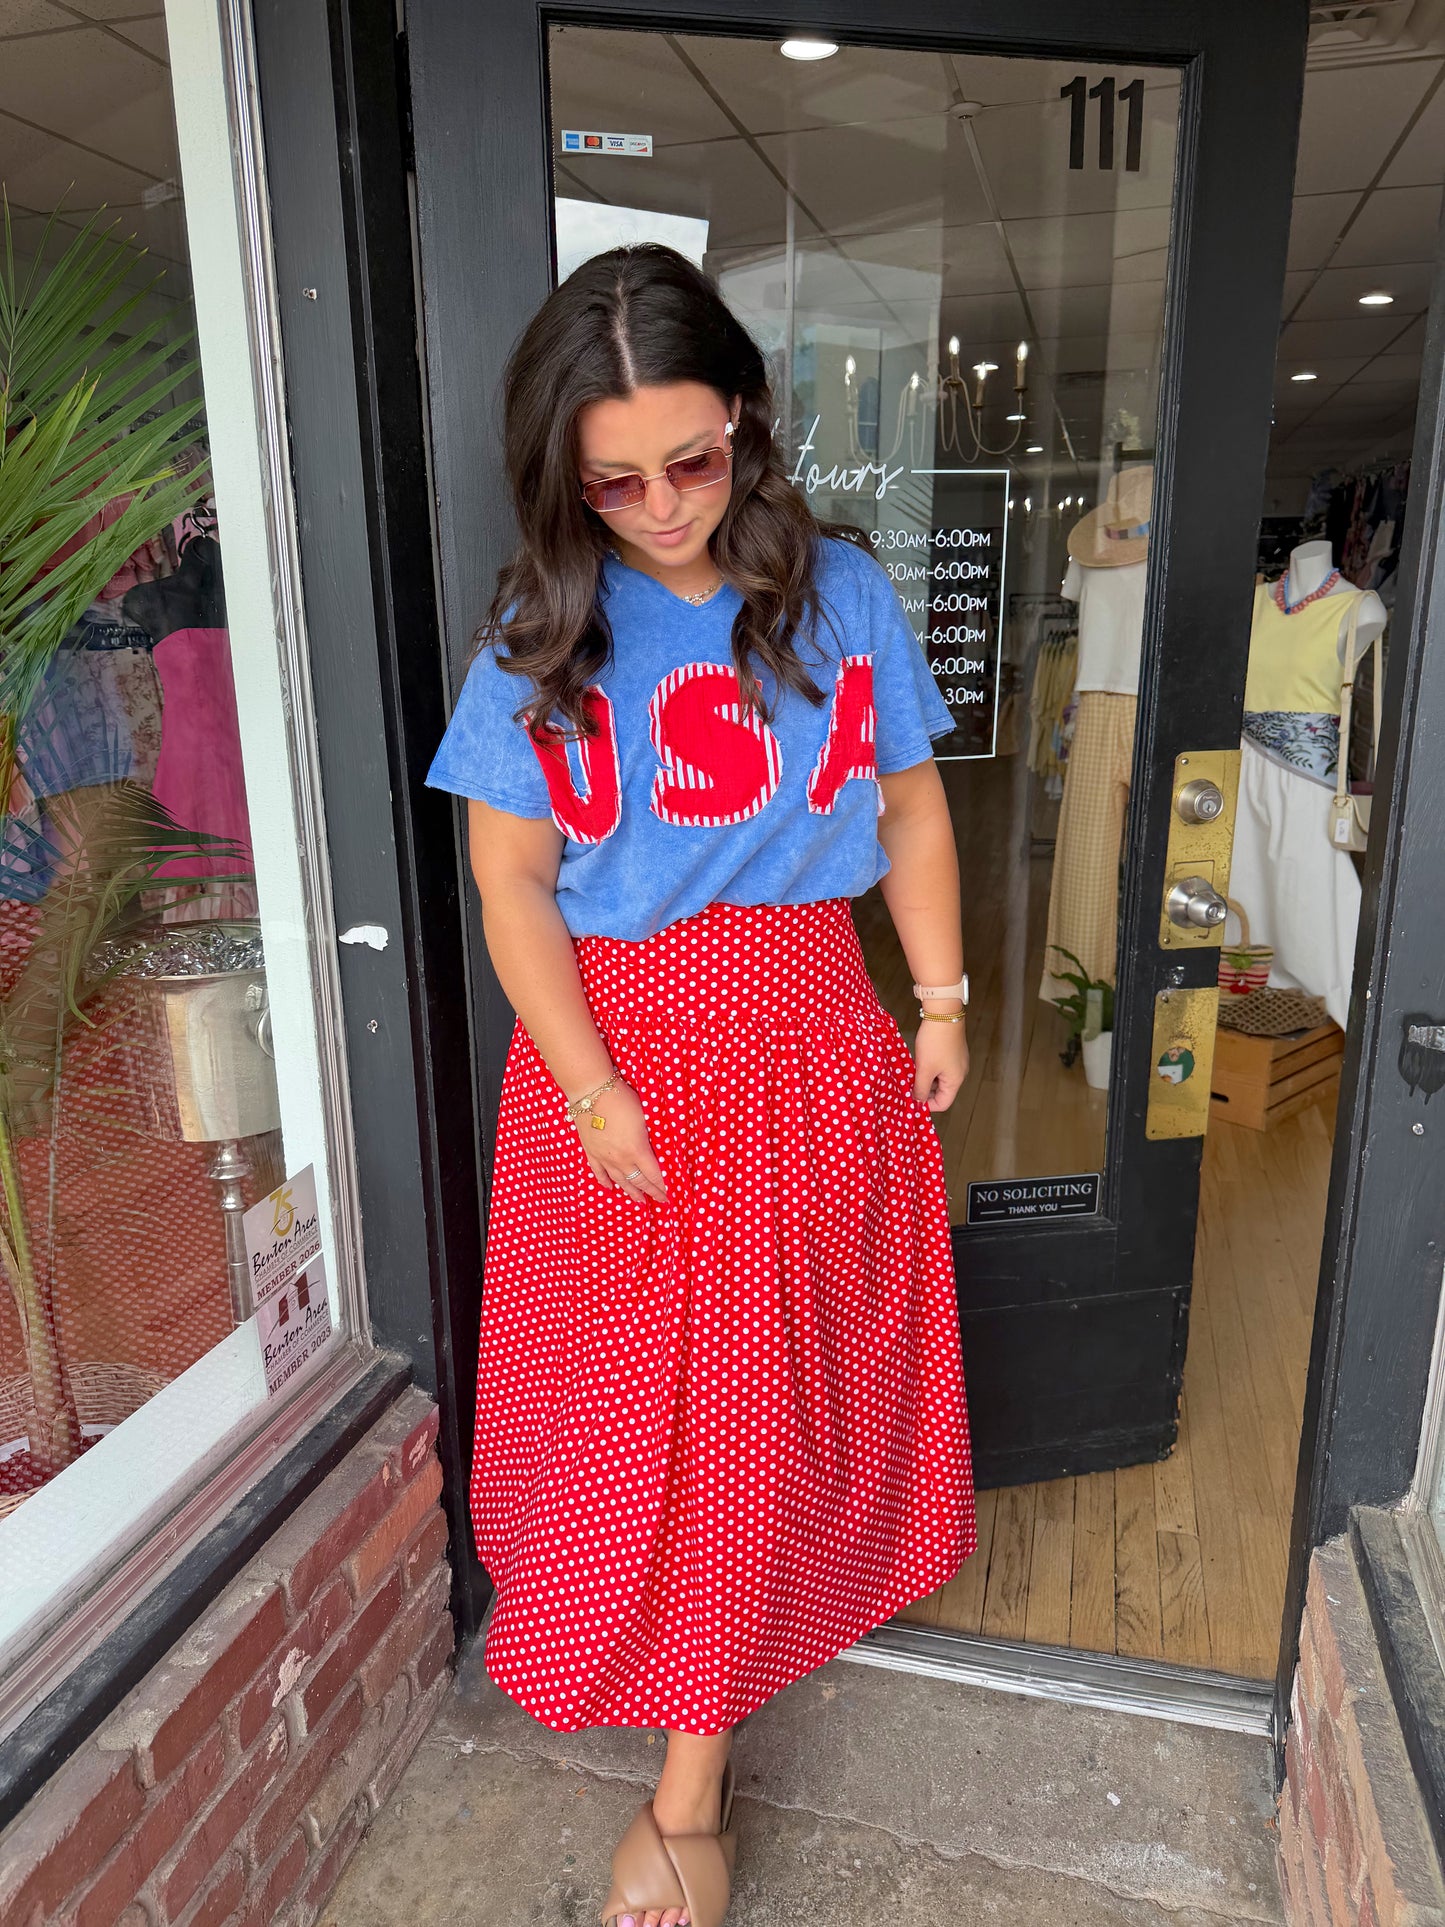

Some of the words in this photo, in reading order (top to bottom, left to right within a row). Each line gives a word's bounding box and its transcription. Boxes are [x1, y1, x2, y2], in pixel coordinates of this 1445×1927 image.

[1061, 76, 1144, 172] 111
[870, 529, 991, 549] 9:30AM-6:00PM
[269, 1187, 294, 1237] 75
[976, 1190, 999, 1203] NO
[1003, 1183, 1093, 1200] SOLICITING
[1008, 1204, 1037, 1214] THANK
[1039, 1203, 1058, 1212] YOU
[252, 1237, 292, 1275] Benton
[294, 1214, 317, 1240] Area
[257, 1261, 297, 1301] MEMBER
[263, 1325, 303, 1368] Benton
[305, 1297, 328, 1328] Area
[269, 1349, 309, 1396] MEMBER
